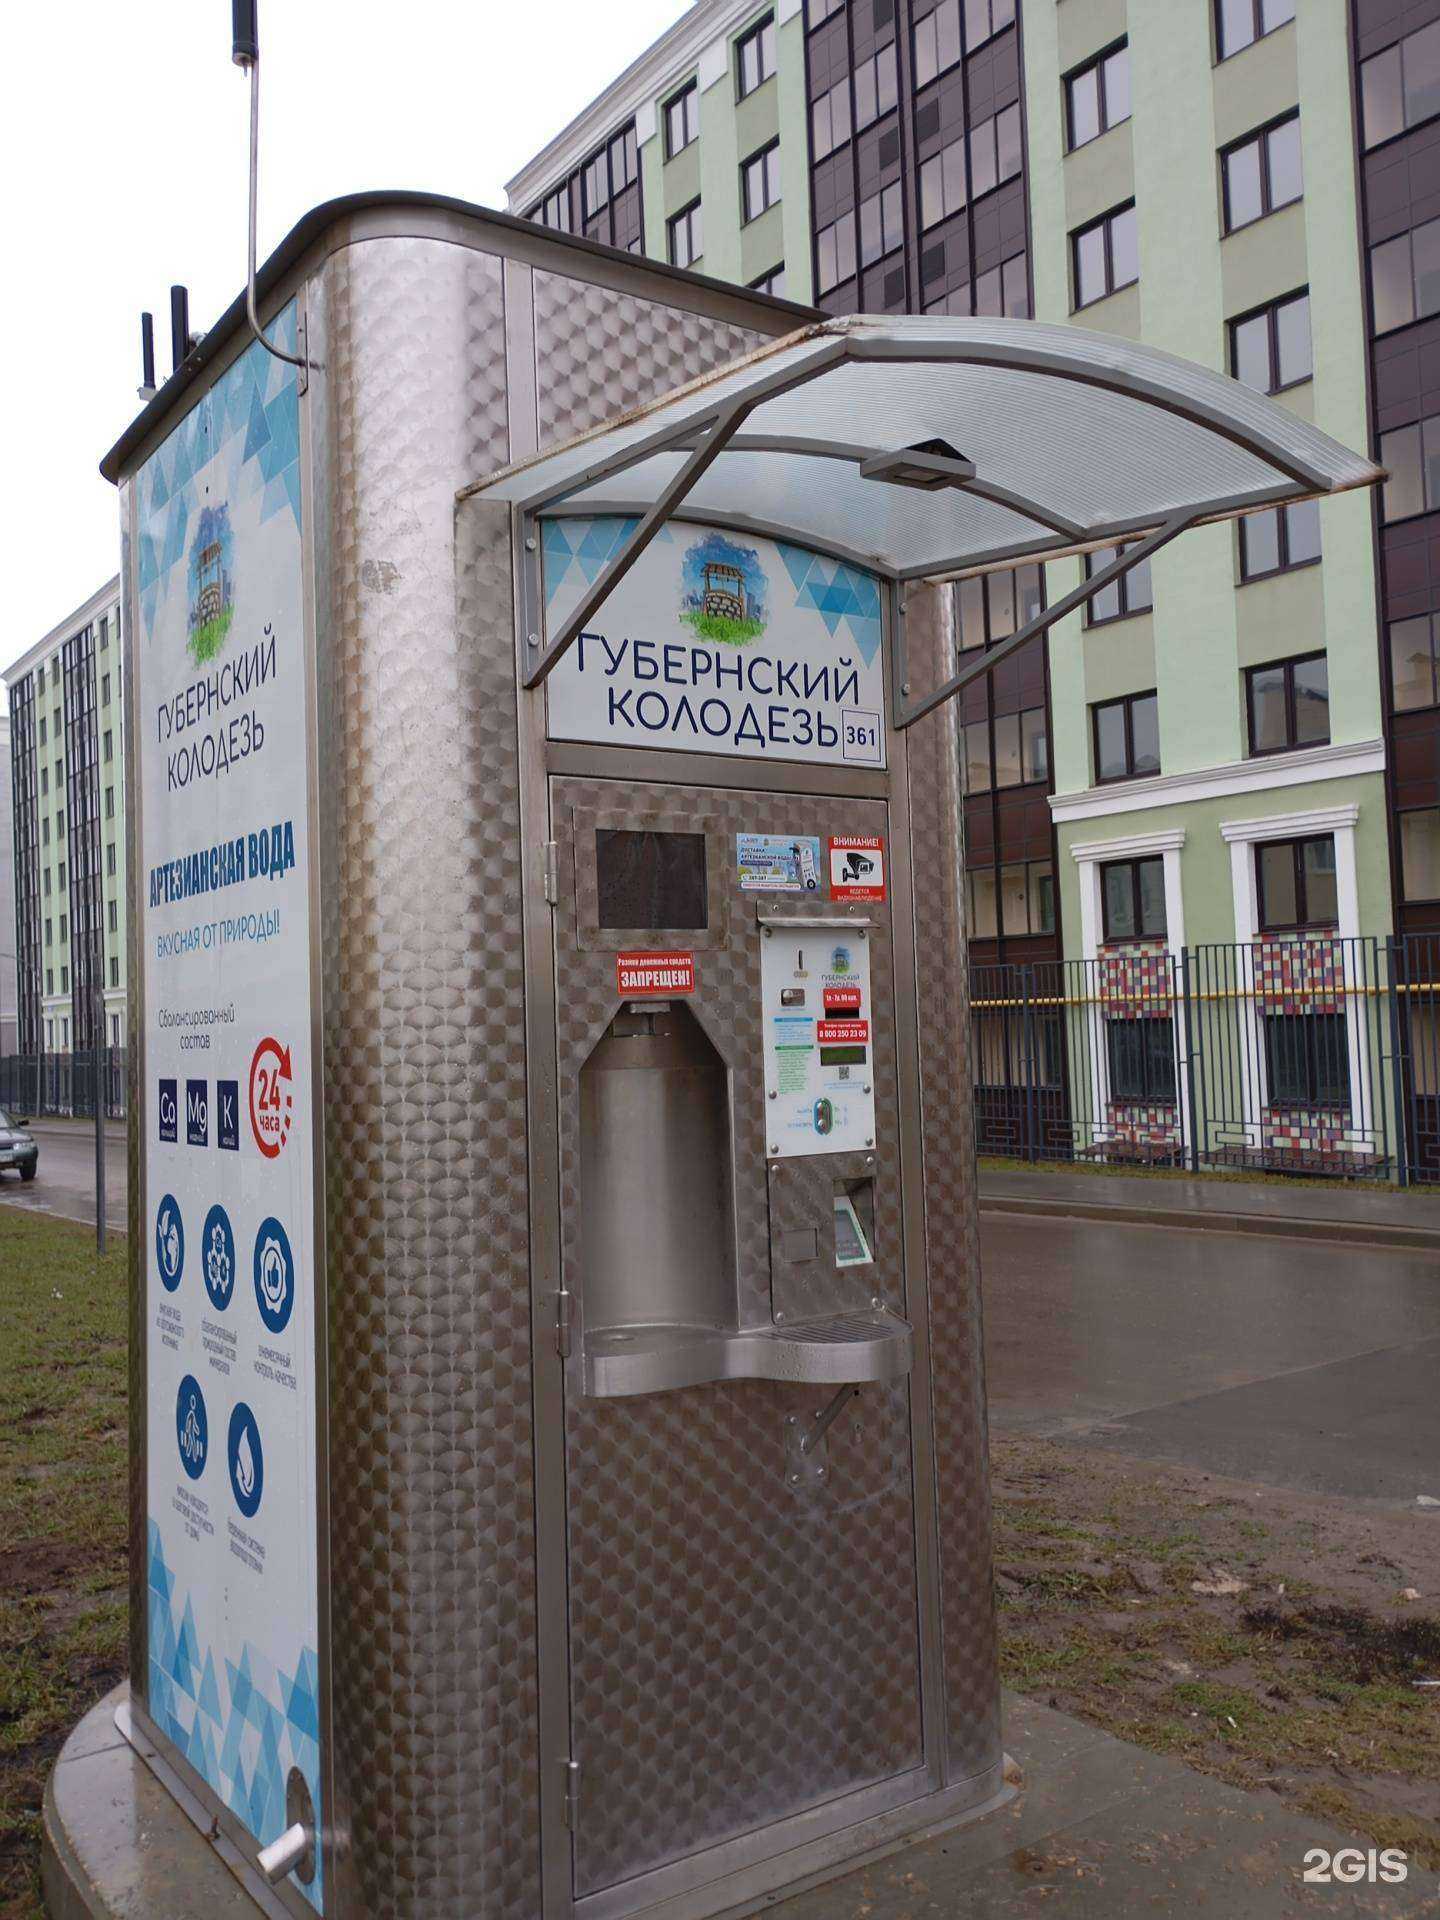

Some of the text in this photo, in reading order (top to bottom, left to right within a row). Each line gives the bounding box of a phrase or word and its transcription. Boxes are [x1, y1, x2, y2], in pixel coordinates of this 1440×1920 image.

[158, 623, 276, 743] ГУБЕРНСКИЙ
[578, 633, 859, 705] ГУБЕРНСКИЙ
[608, 687, 838, 748] КОЛОДЕЗЬ
[846, 726, 876, 747] 361
[168, 710, 264, 792] КОЛОДЕЗЬ
[833, 837, 879, 847] ВНИМАНИЕ!
[150, 821, 295, 908] АРТЕЗИАНСКАЯ ВОДА
[157, 909, 280, 959] ВКУСНАЯ ОТ ПРИРОДЫ!
[621, 970, 690, 988] ЗАПРЕЩЕН!
[158, 1003, 235, 1029] Сбалансированный
[180, 1034, 210, 1050] состав
[160, 1092, 176, 1124] Ca
[258, 1069, 281, 1111] 24
[187, 1091, 208, 1133] Mg
[259, 1115, 280, 1132] часа
